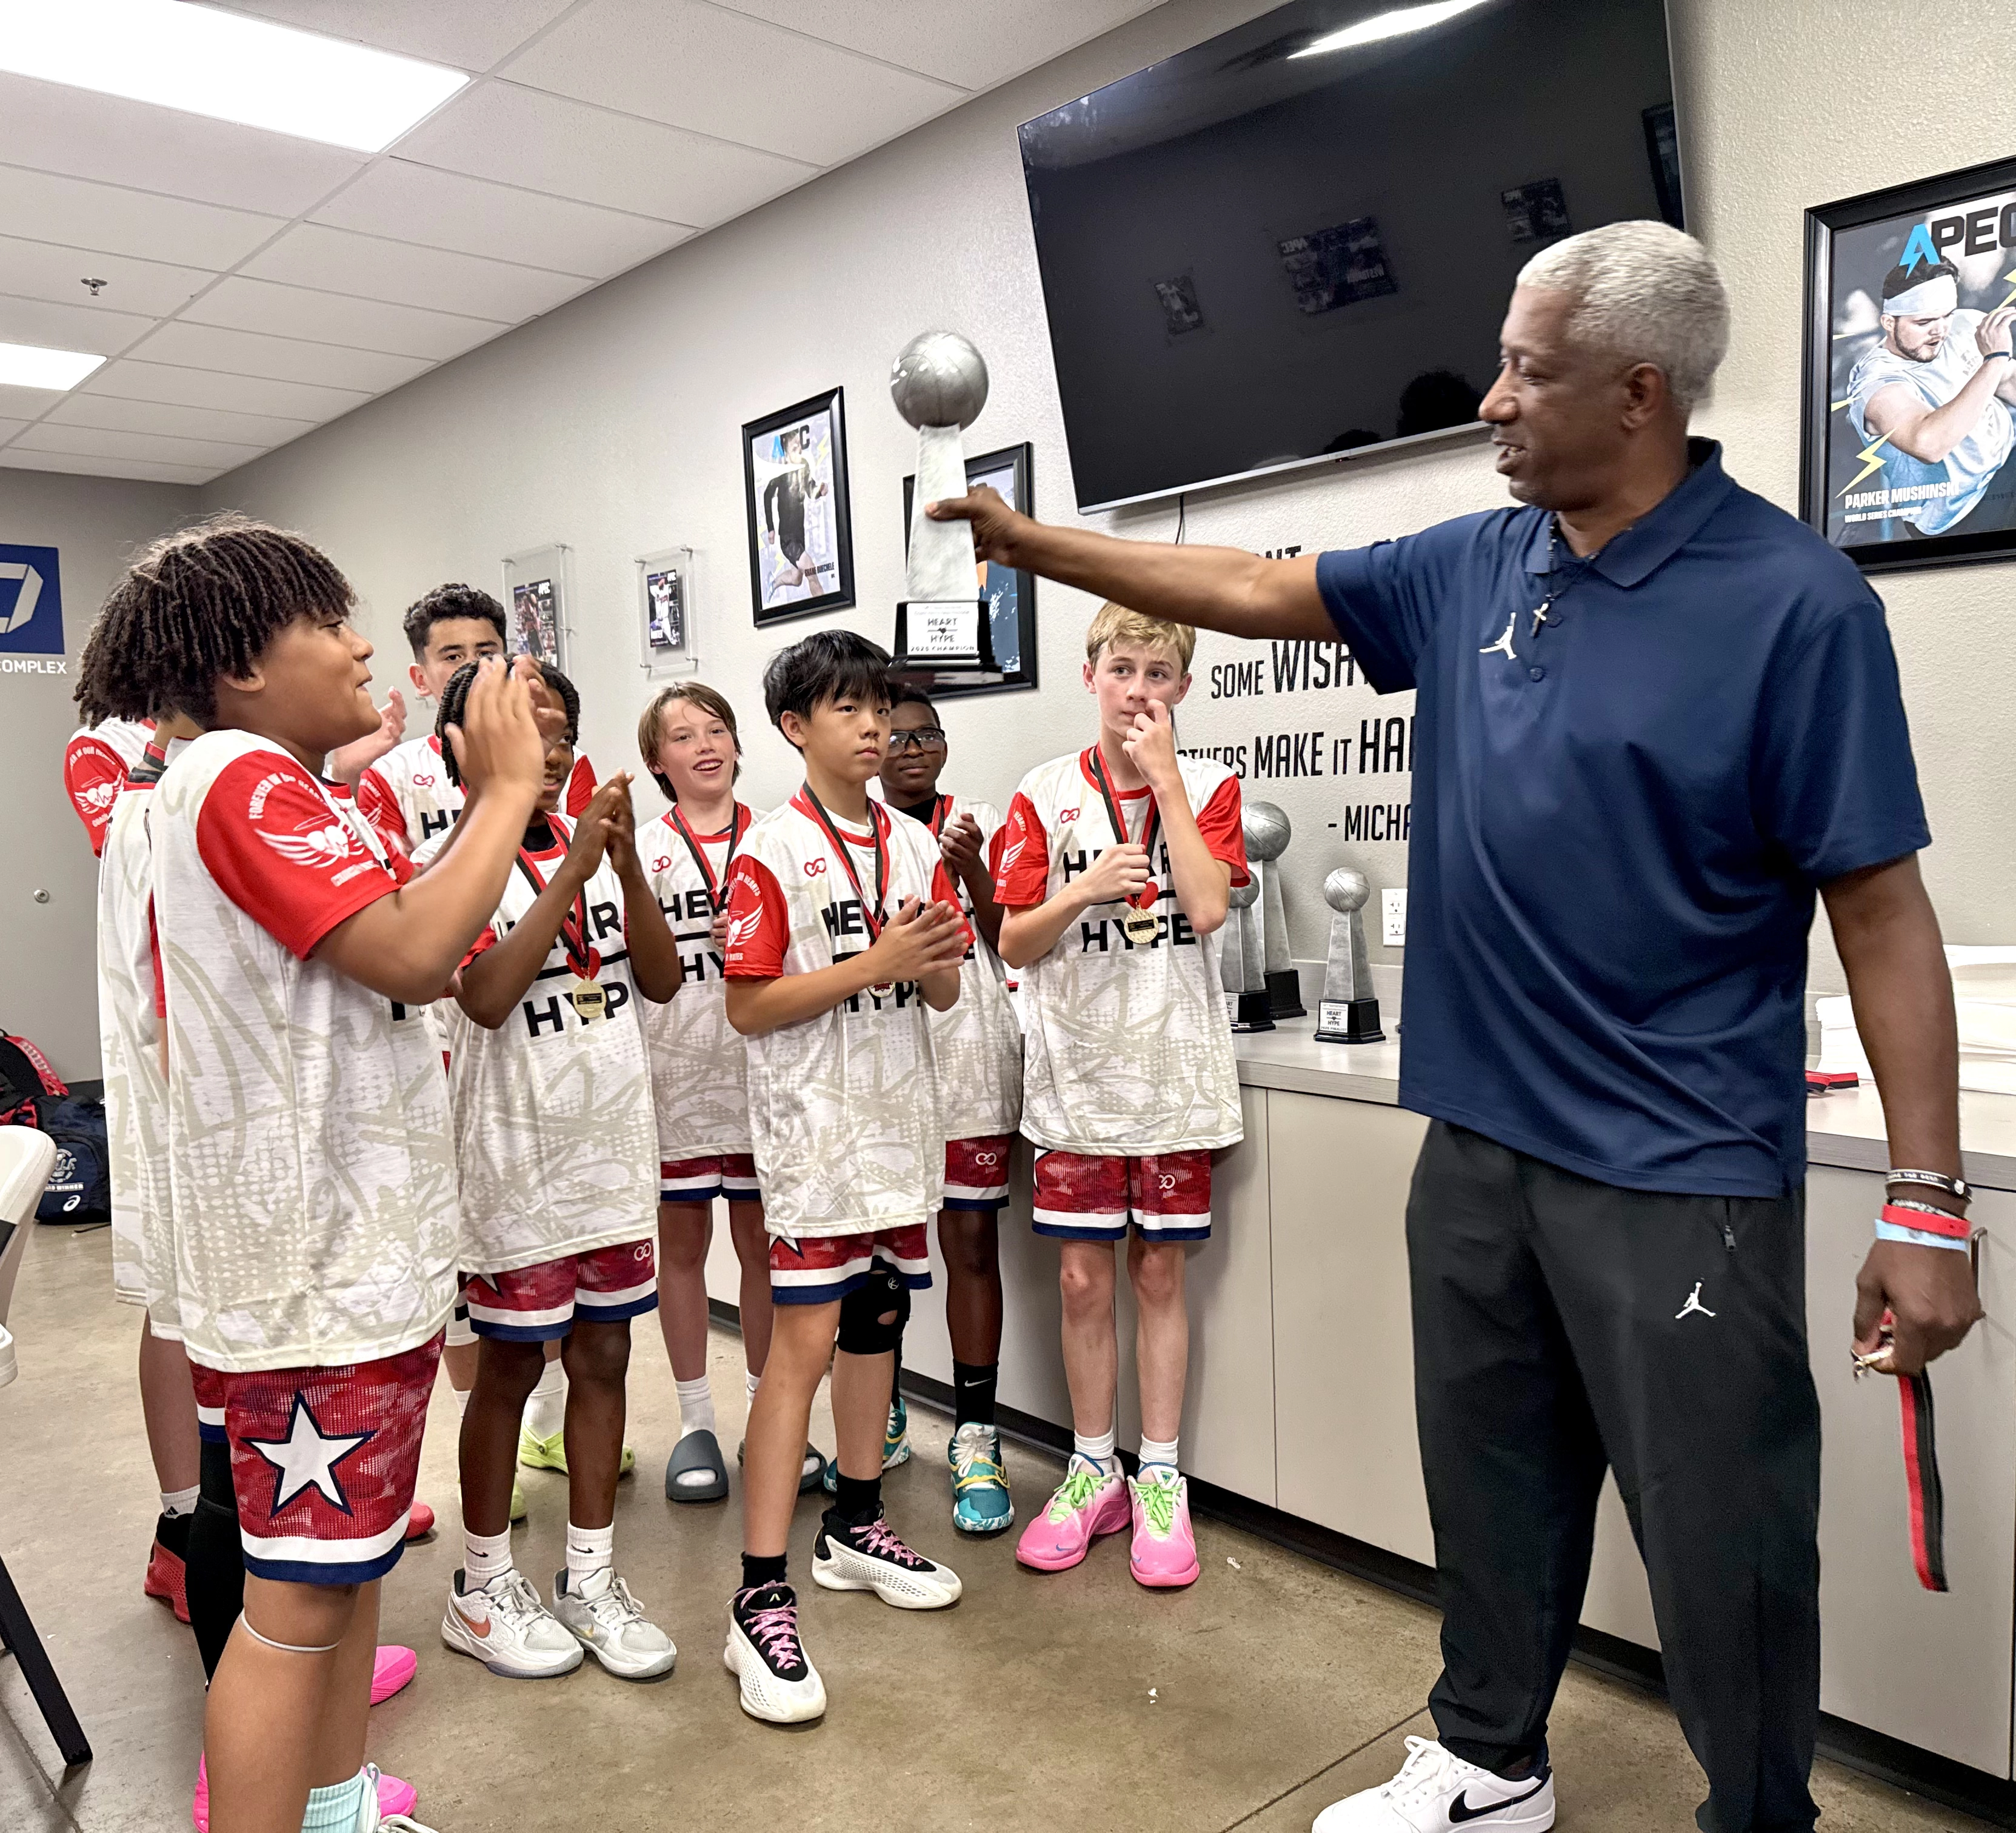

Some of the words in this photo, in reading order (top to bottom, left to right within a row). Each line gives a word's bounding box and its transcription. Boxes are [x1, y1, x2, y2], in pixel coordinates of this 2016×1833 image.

[1845, 490, 1890, 509] PARKER
[1844, 513, 1867, 523] WORLD
[1867, 510, 1887, 520] SERIES
[927, 618, 958, 627] HEART
[930, 634, 955, 643] HYPE
[0, 659, 67, 674] OMPLEX
[1211, 660, 1264, 699] SOME
[1255, 732, 1324, 779] MAKE
[1333, 738, 1352, 775] IT
[1359, 716, 1415, 774] HA
[249, 779, 275, 820] FOREVER
[1344, 804, 1411, 841] MICHA
[743, 874, 761, 897] HEARTS
[522, 981, 629, 1038] HYP
